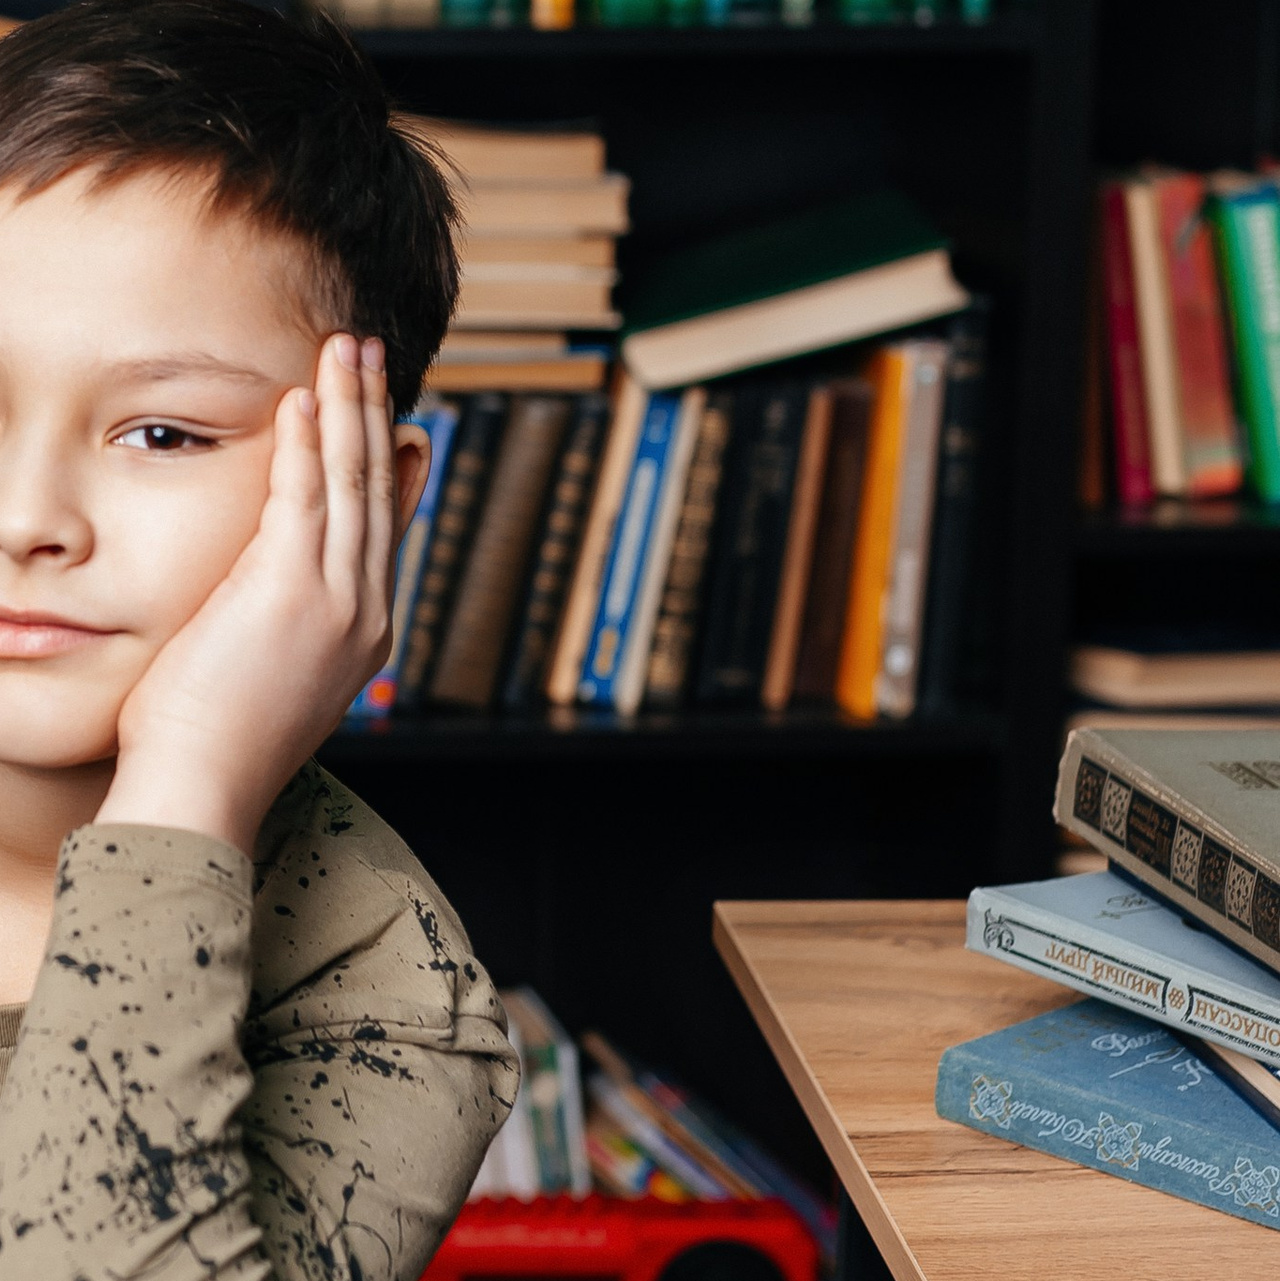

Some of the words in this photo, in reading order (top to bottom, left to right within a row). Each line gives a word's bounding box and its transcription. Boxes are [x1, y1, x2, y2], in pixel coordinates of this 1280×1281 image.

[1045, 941, 1091, 973] ДРУГ
[1091, 957, 1161, 1001] МИЛЫЙ
[1195, 996, 1280, 1048] ОПАССАН
[1137, 1135, 1240, 1196] Рассказы
